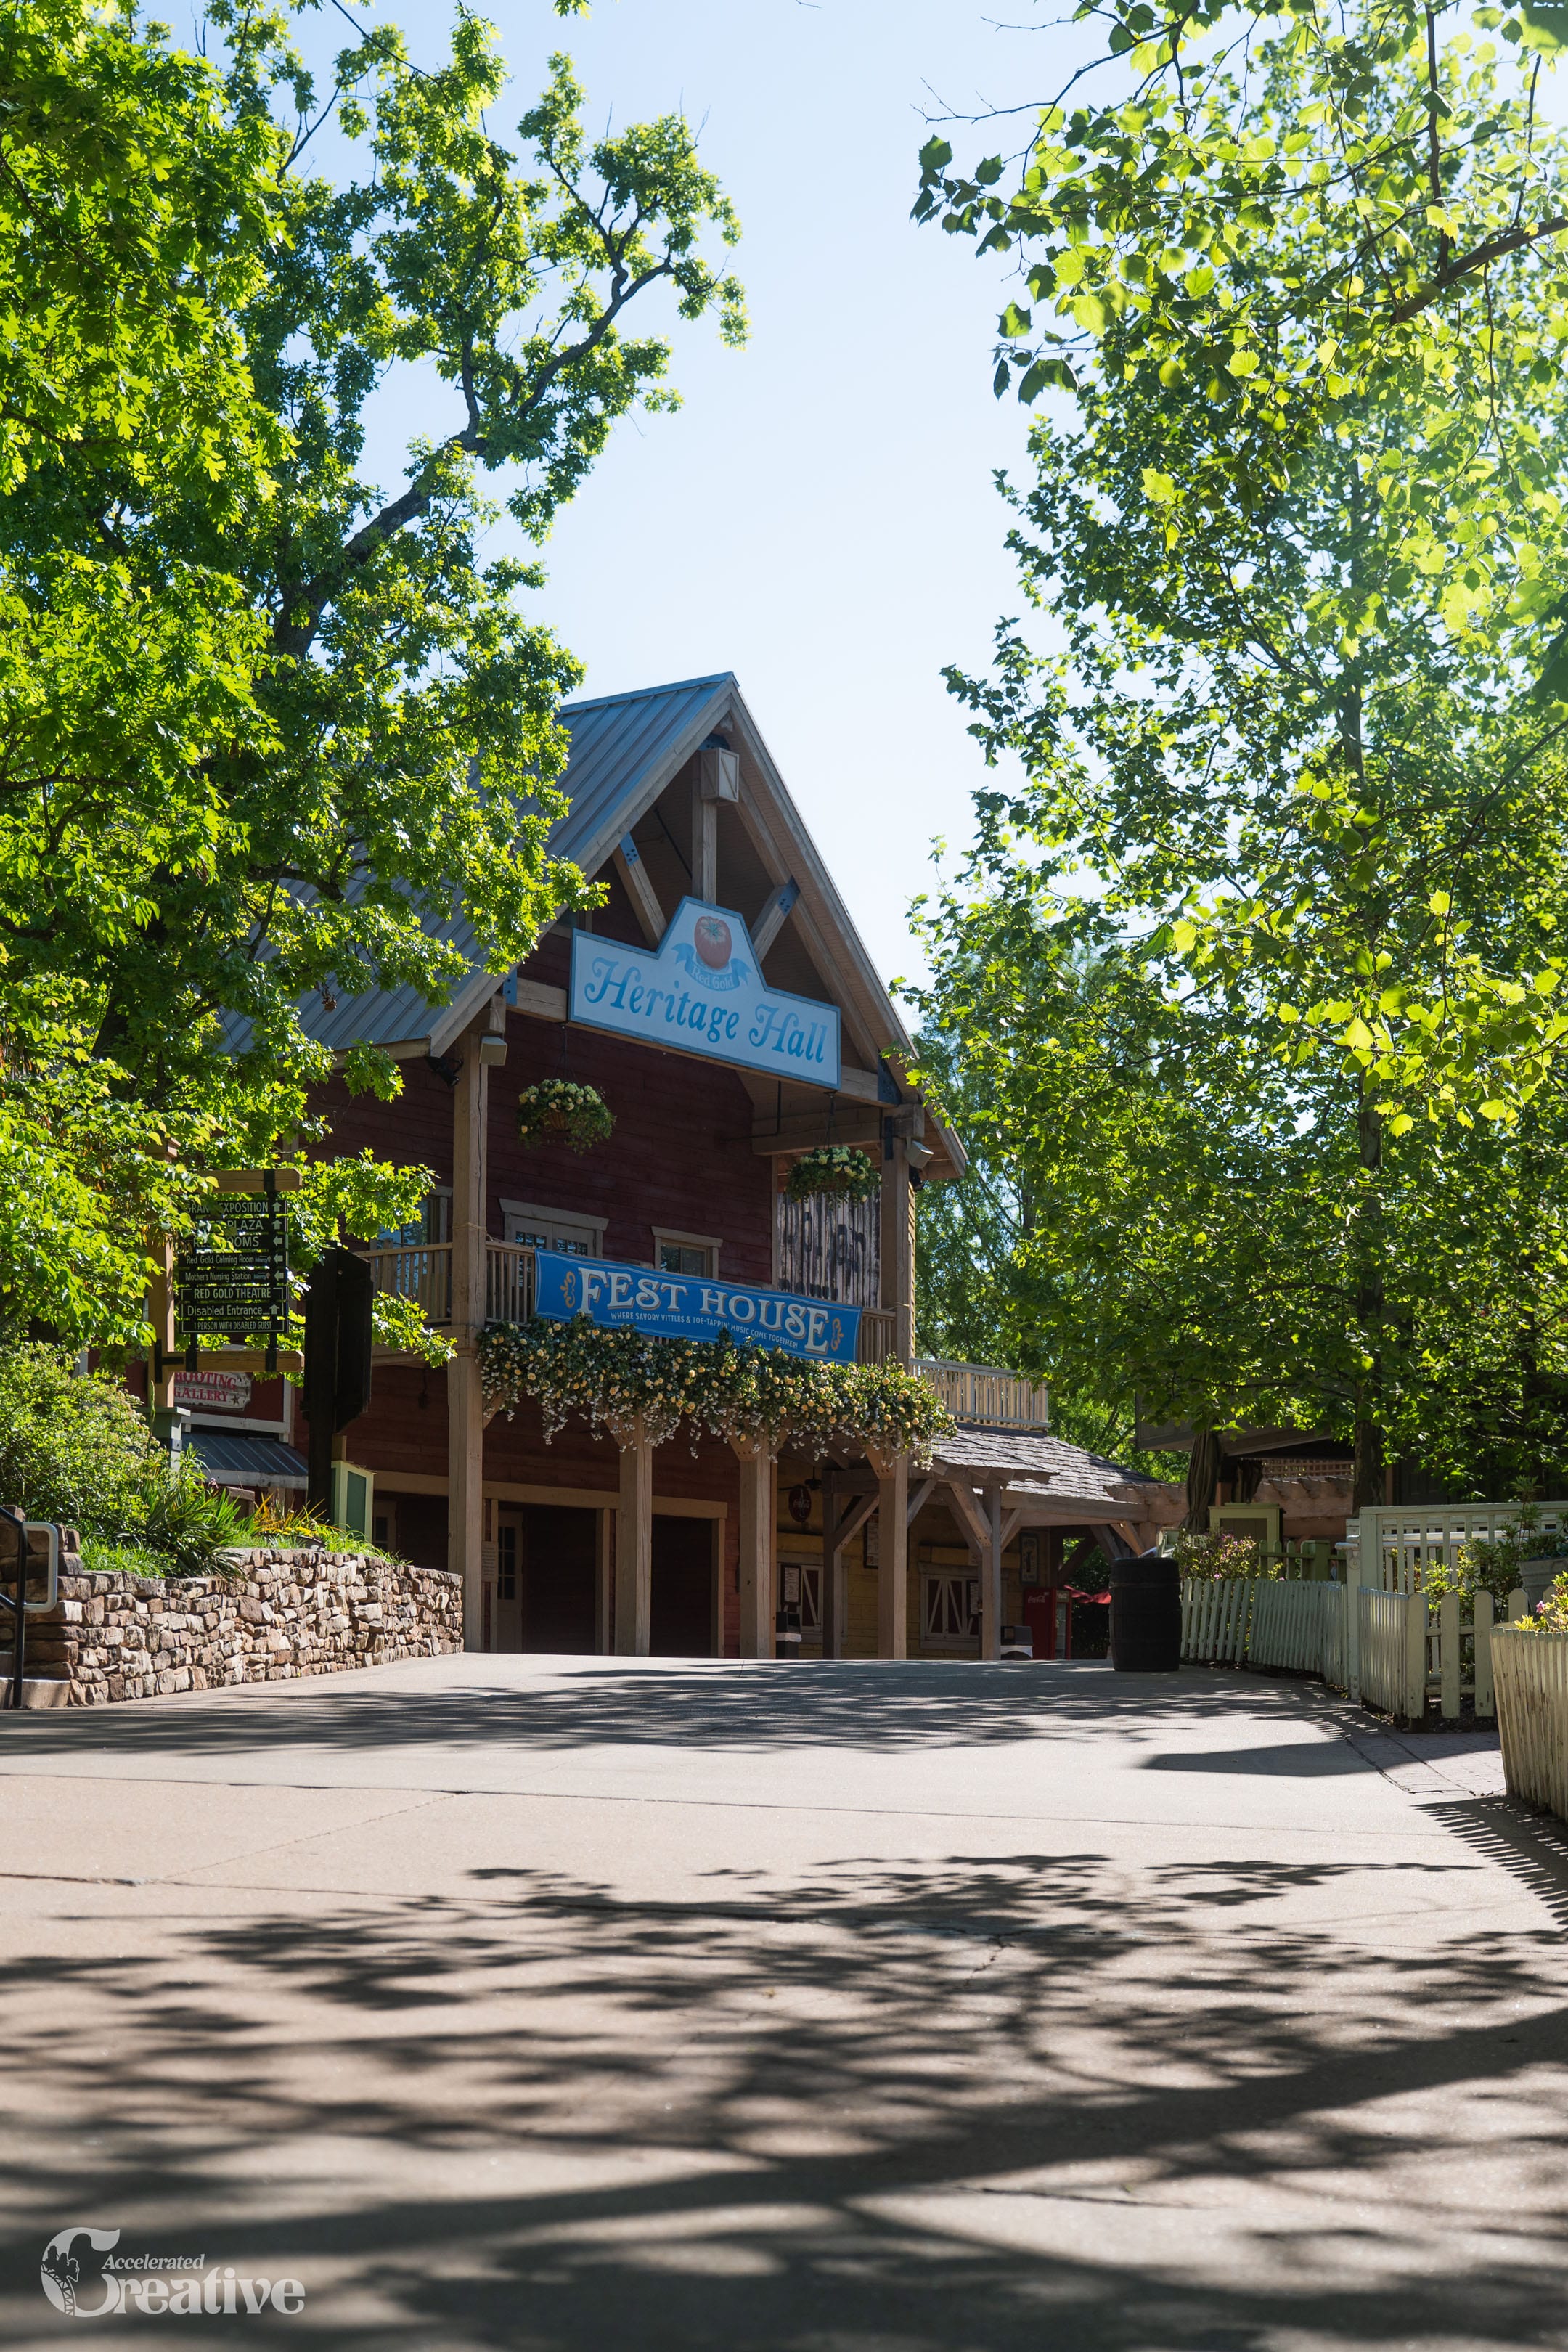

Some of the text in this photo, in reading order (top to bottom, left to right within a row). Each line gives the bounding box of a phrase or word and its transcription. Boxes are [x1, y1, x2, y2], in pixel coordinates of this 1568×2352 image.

[692, 965, 734, 989] Red Gold
[584, 957, 828, 1063] Heritage Hall
[219, 1201, 269, 1213] XPOSITION
[227, 1220, 264, 1230] PLAZA
[200, 1255, 213, 1264] Gold
[216, 1255, 237, 1265] Calming
[239, 1254, 254, 1263] Room
[185, 1272, 209, 1281] Mother's
[210, 1273, 230, 1282] Nursing
[231, 1272, 252, 1281] Station
[194, 1287, 271, 1299] RED GOLD THEATRE
[187, 1305, 263, 1316] Disabled Entrance
[576, 1267, 689, 1318] FEST
[699, 1288, 830, 1355] HOUSE
[197, 1321, 218, 1330] PERSON
[219, 1321, 232, 1330] WITH
[233, 1321, 256, 1330] DISABLED
[635, 1312, 659, 1321] SAVORY
[661, 1314, 685, 1323] VITTLES
[693, 1316, 730, 1328] TOE-TAPPIN'
[730, 1323, 750, 1335] MUSIC
[751, 1329, 767, 1339] COME
[768, 1334, 799, 1349] TOGETHER!
[174, 1371, 237, 1391] HOOTING
[174, 1386, 229, 1402] GALLERY
